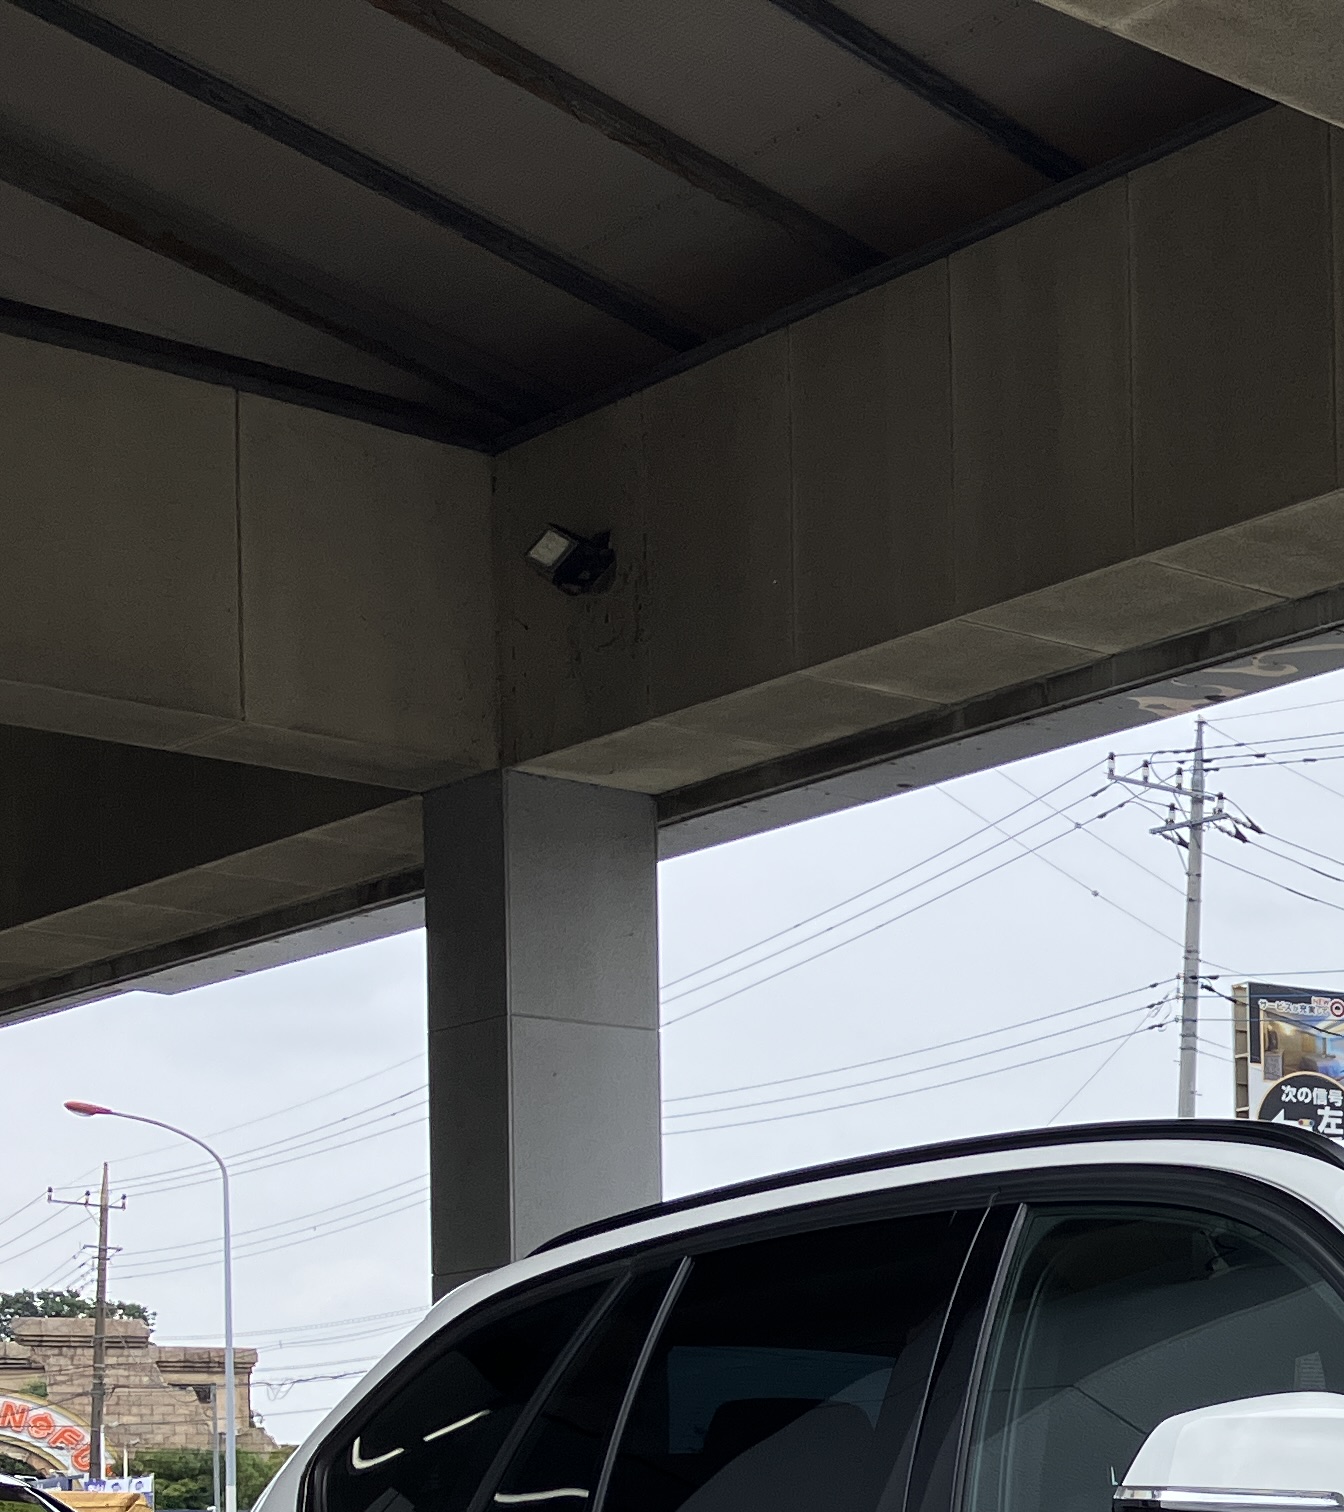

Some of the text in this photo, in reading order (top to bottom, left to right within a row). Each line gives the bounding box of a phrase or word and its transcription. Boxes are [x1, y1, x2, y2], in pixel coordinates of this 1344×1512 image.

[1281, 1085, 1344, 1107] 次の信号
[1317, 1106, 1344, 1135] 左
